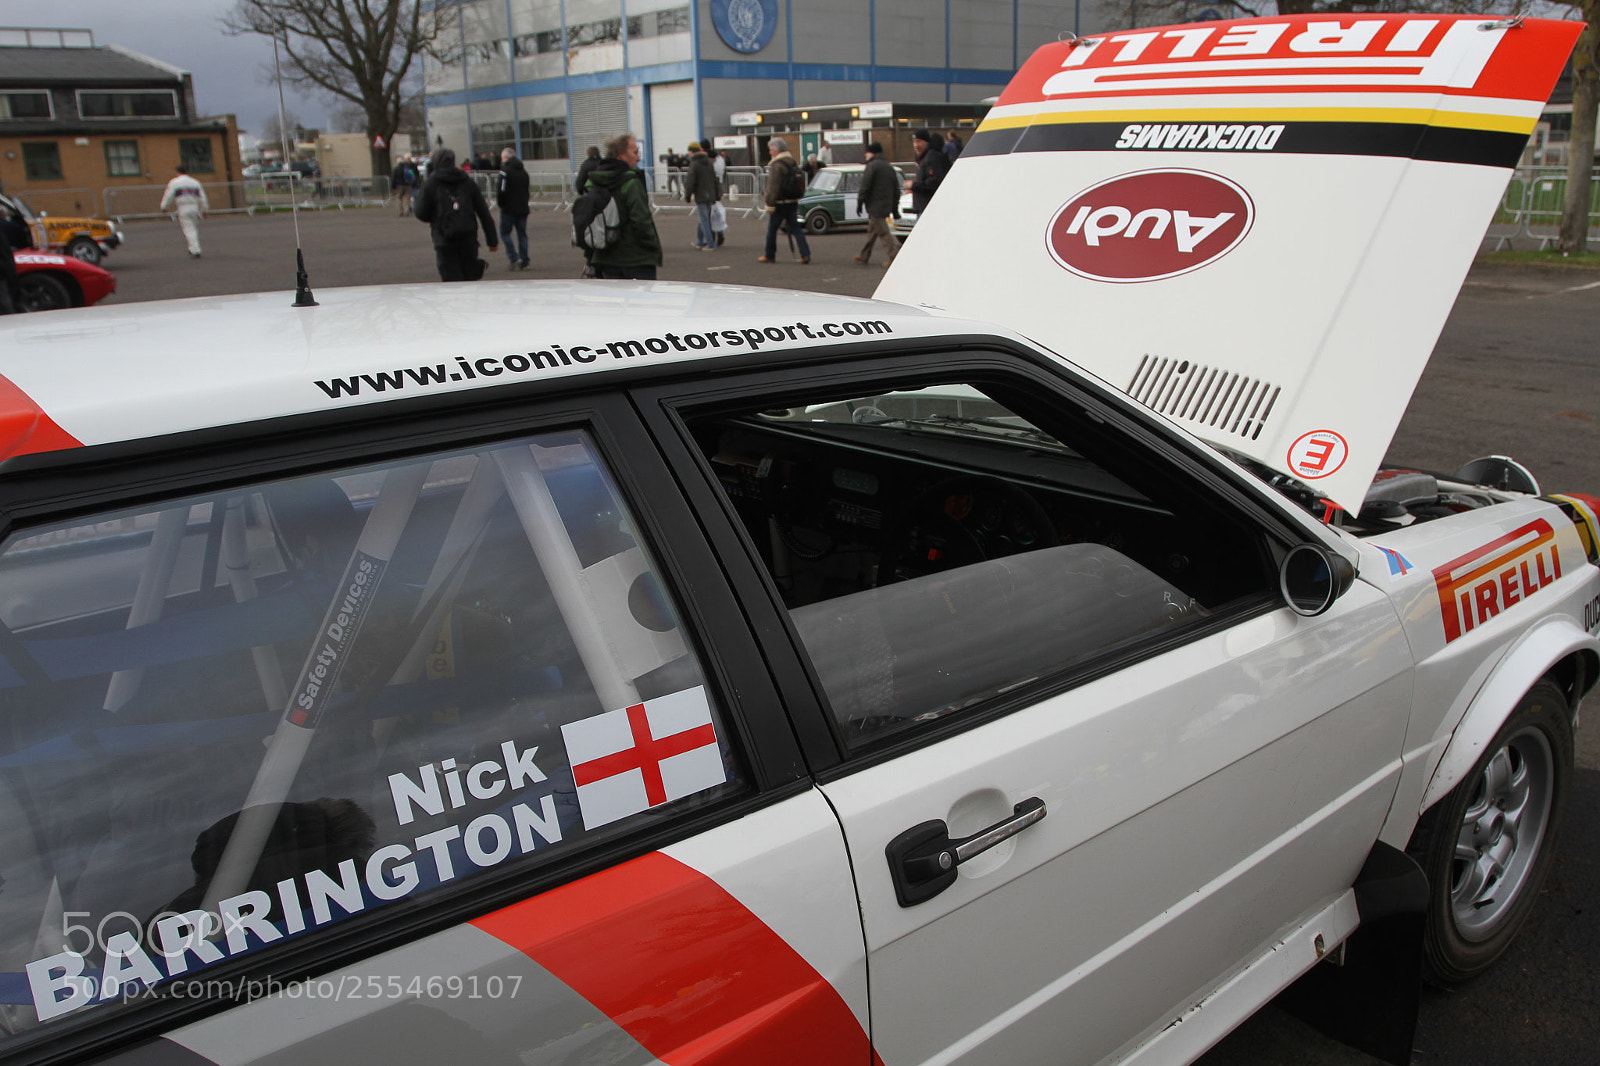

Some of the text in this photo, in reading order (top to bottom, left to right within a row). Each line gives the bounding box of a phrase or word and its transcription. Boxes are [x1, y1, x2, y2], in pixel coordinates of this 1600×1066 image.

[1042, 19, 1509, 96] PIRELLI
[1115, 124, 1286, 150] DUCKHAMS
[313, 319, 893, 399] www.iconic-motorsport.com
[1299, 438, 1336, 471] E
[1431, 517, 1562, 645] PIRELLI
[298, 643, 337, 710] Safety
[327, 559, 372, 642] Devices
[388, 740, 548, 825] Nick
[26, 794, 563, 1021] BARRINGTON
